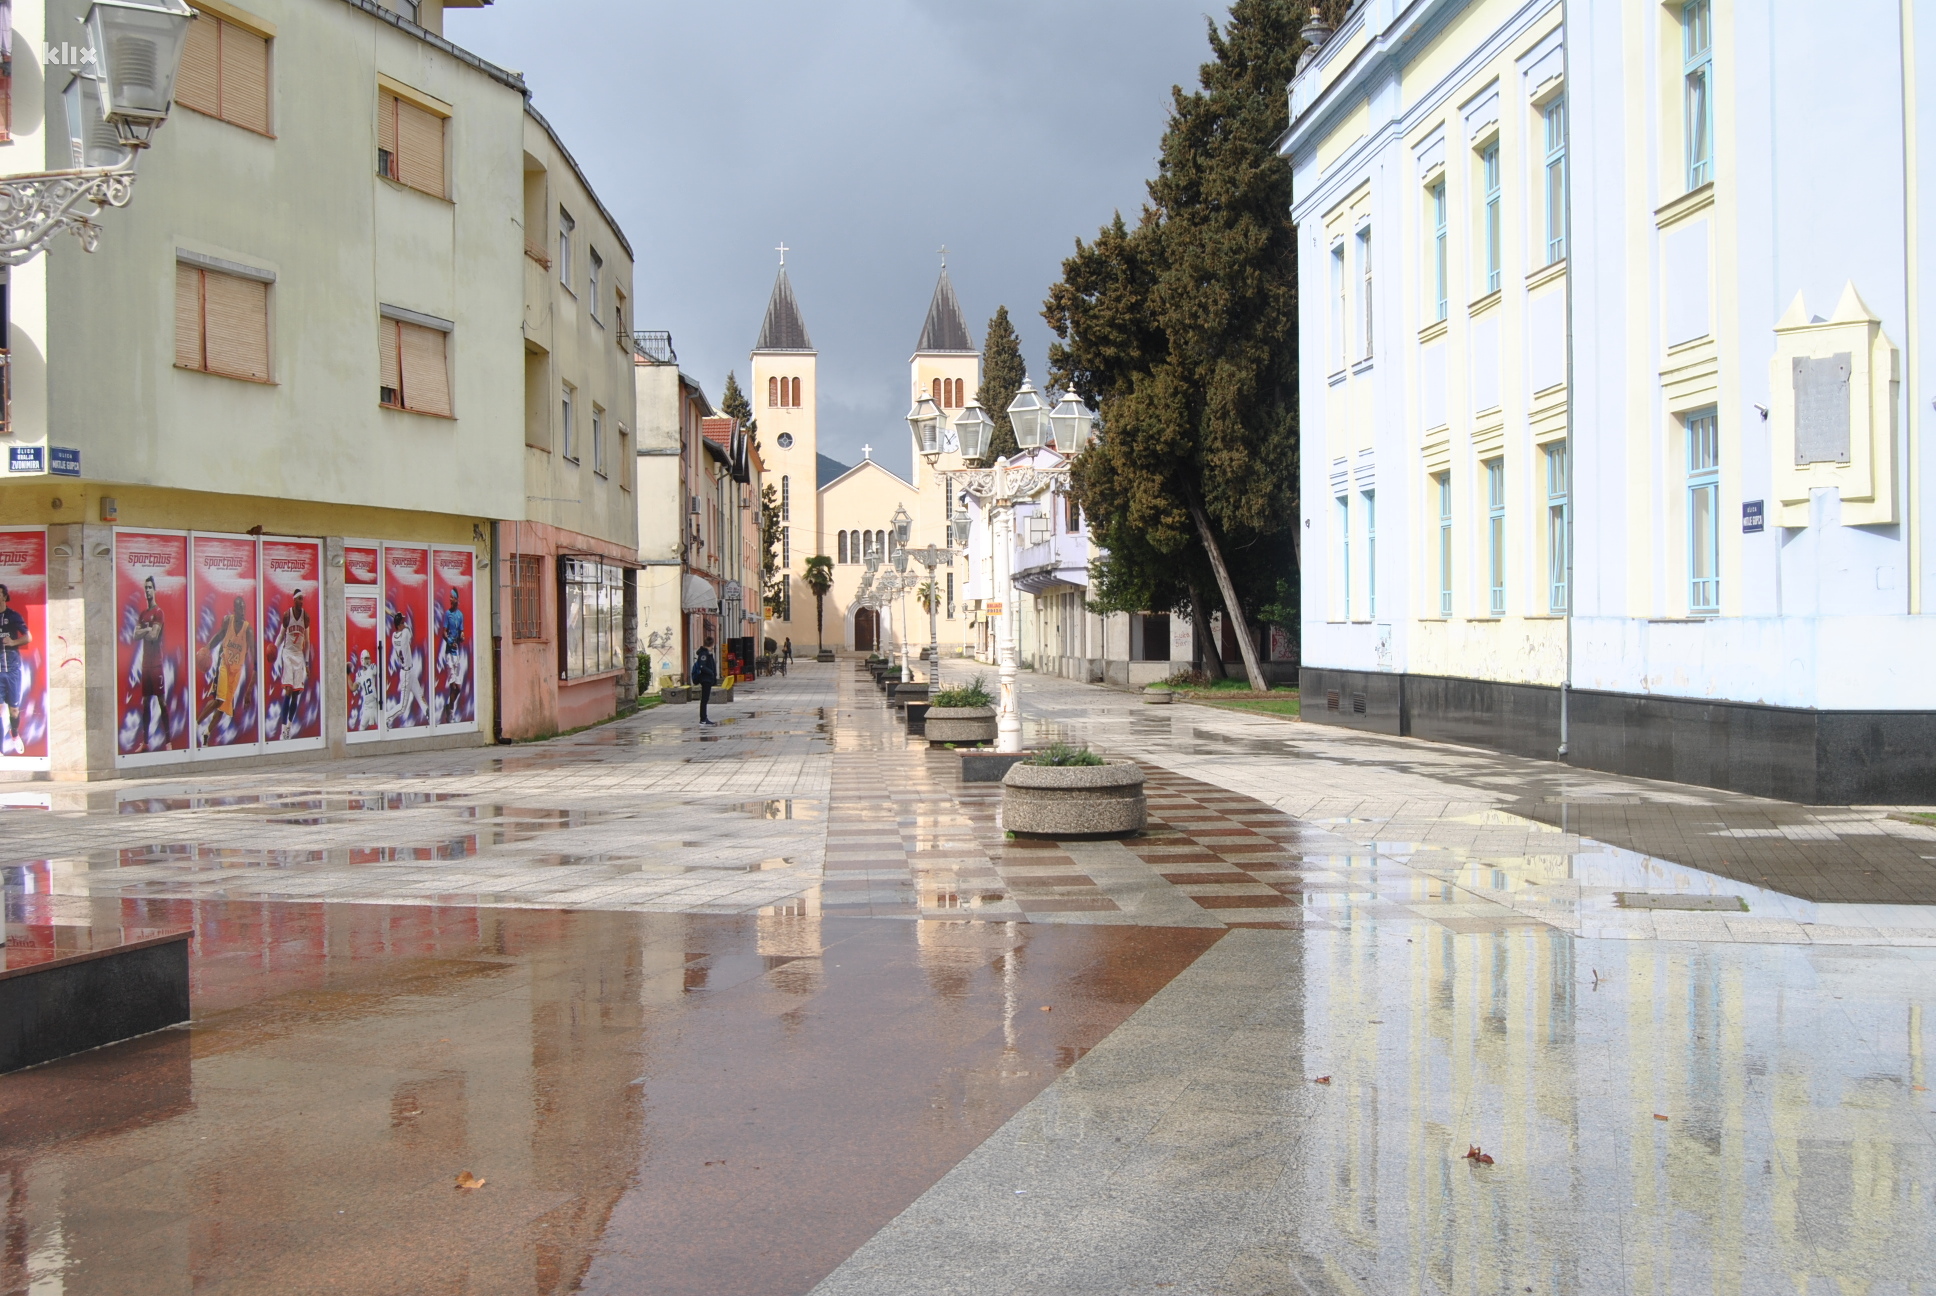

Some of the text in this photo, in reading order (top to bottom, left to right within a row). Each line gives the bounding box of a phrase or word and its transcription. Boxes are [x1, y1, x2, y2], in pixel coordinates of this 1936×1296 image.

[11, 460, 40, 470] ZVONIMIRA
[128, 552, 172, 567] sportplus
[203, 555, 244, 570] sportplus
[270, 558, 307, 572] sportplus
[392, 557, 418, 567] sportplus
[293, 633, 300, 644] 7
[227, 650, 240, 664] 24
[363, 678, 373, 696] 12
